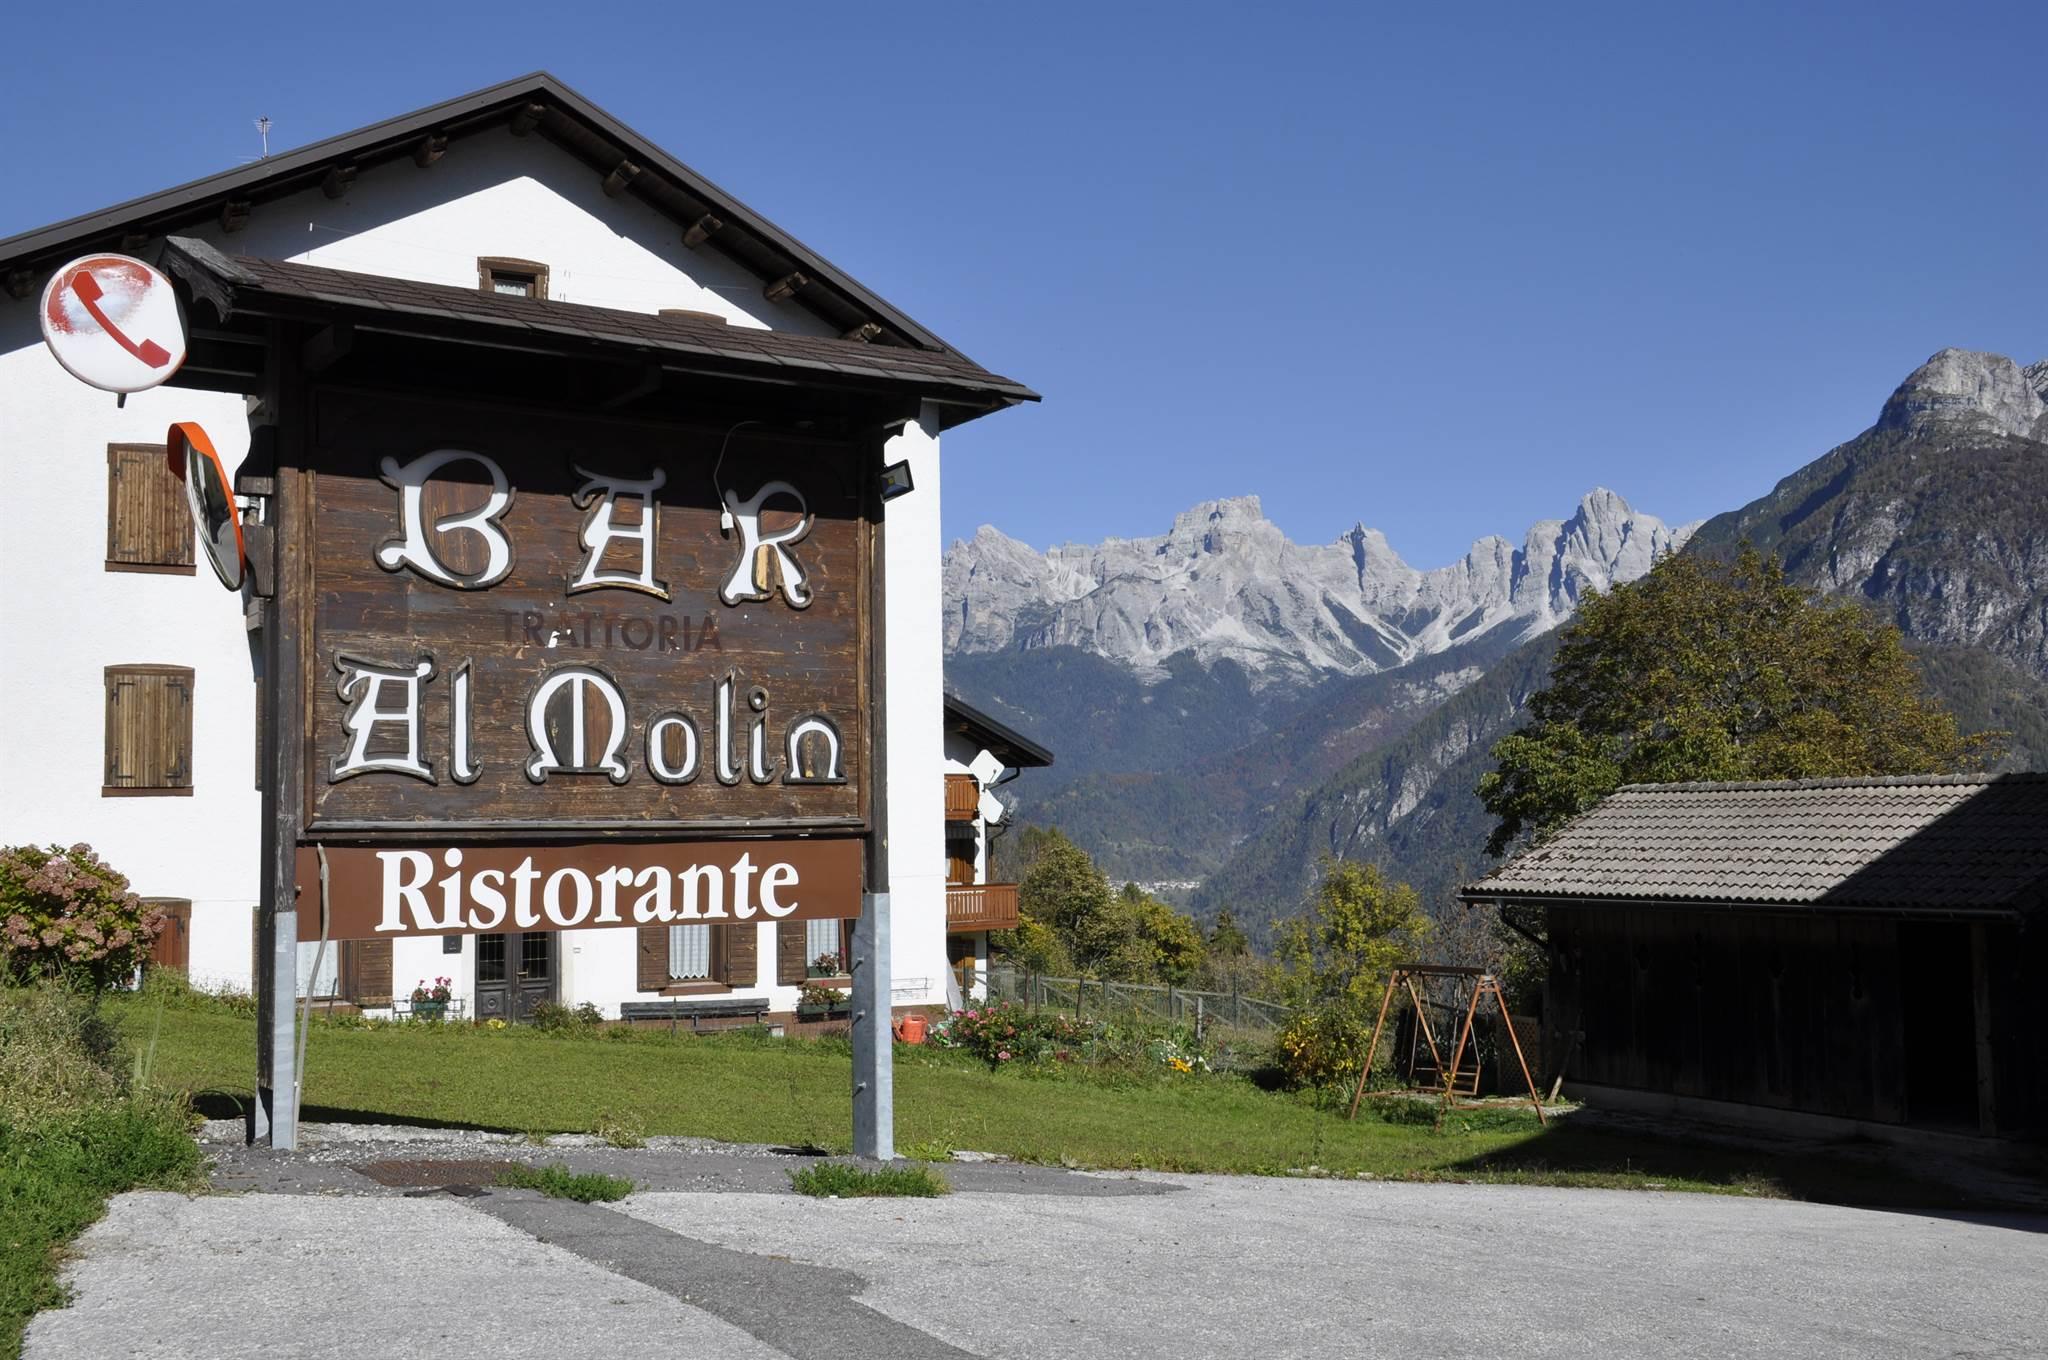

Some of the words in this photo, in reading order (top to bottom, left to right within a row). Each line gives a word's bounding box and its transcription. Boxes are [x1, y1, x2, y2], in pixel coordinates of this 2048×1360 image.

[377, 448, 815, 607] BAR
[500, 609, 722, 651] TRATTORIA
[328, 650, 482, 786] Al
[524, 663, 848, 786] Molin
[375, 848, 800, 932] Ristorante
